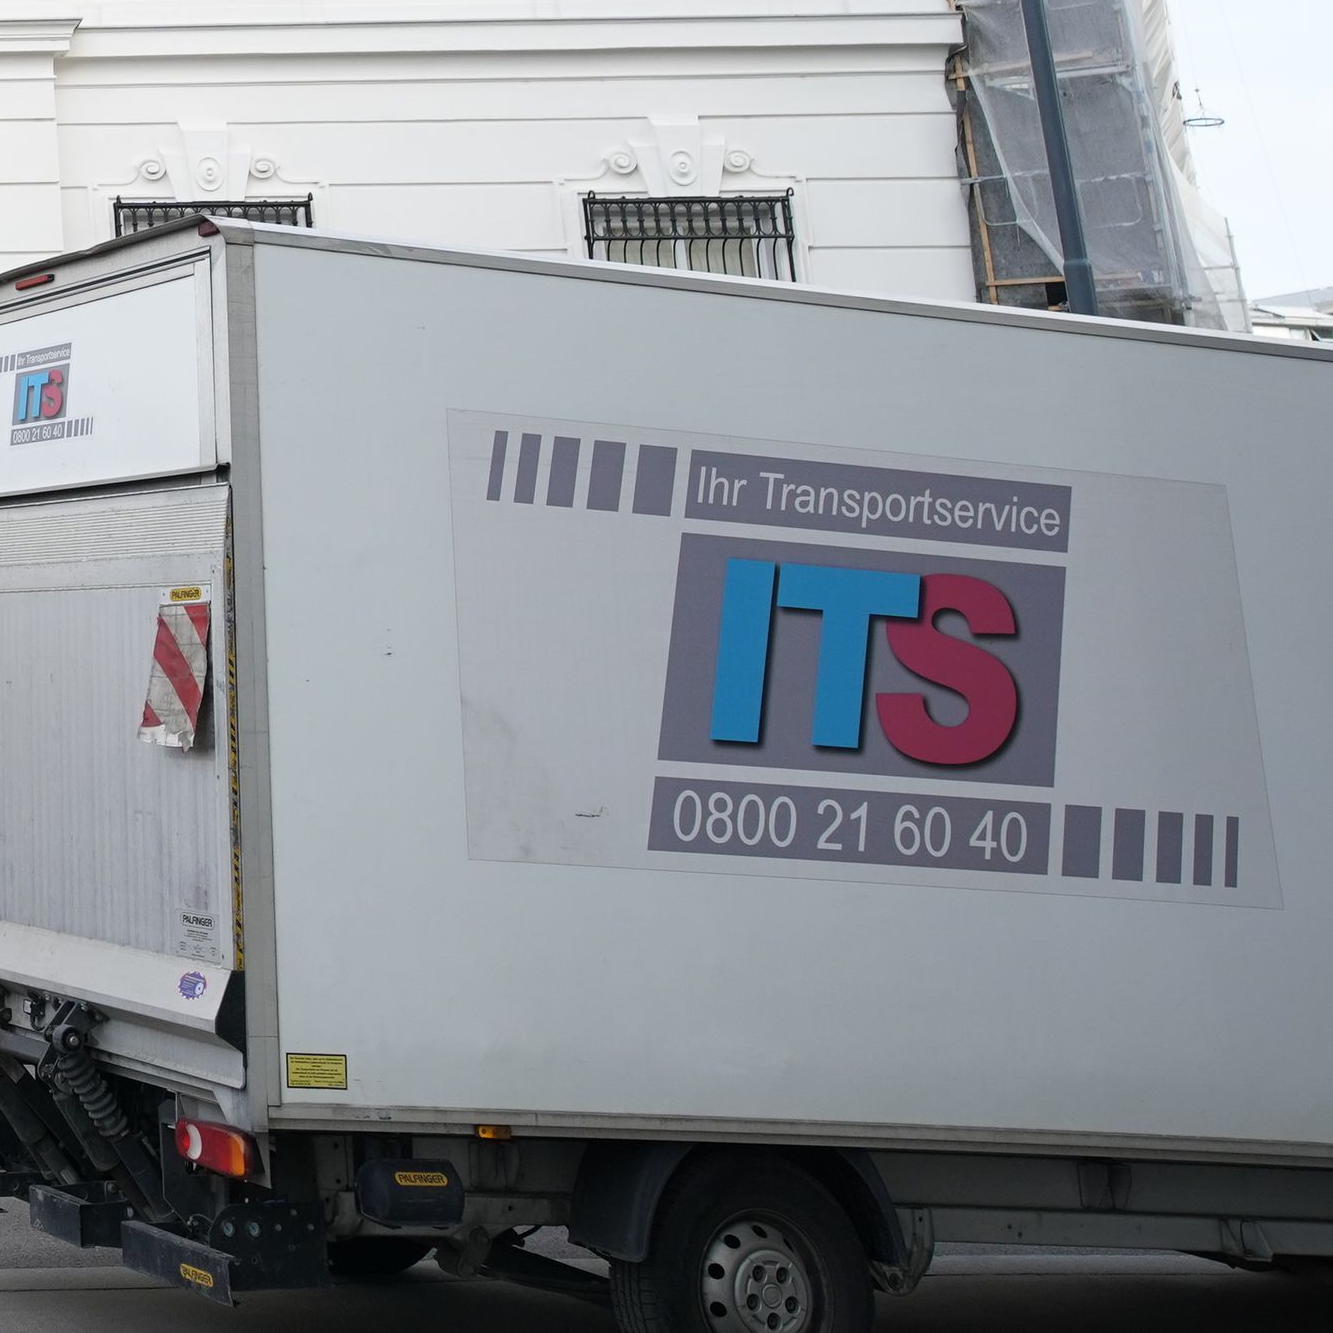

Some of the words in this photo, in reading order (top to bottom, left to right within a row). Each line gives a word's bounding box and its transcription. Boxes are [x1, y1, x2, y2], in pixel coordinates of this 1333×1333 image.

[26, 347, 71, 365] Transportservice
[17, 368, 64, 420] ITS
[696, 465, 747, 508] Ihr
[758, 470, 1062, 538] Transportservice
[709, 557, 1020, 766] ITS
[672, 788, 798, 849] 0800
[816, 798, 870, 852] 21
[893, 803, 953, 858] 60
[968, 808, 1028, 863] 40
[182, 914, 213, 928] PALFINGER
[397, 1173, 445, 1184] PALFINGER
